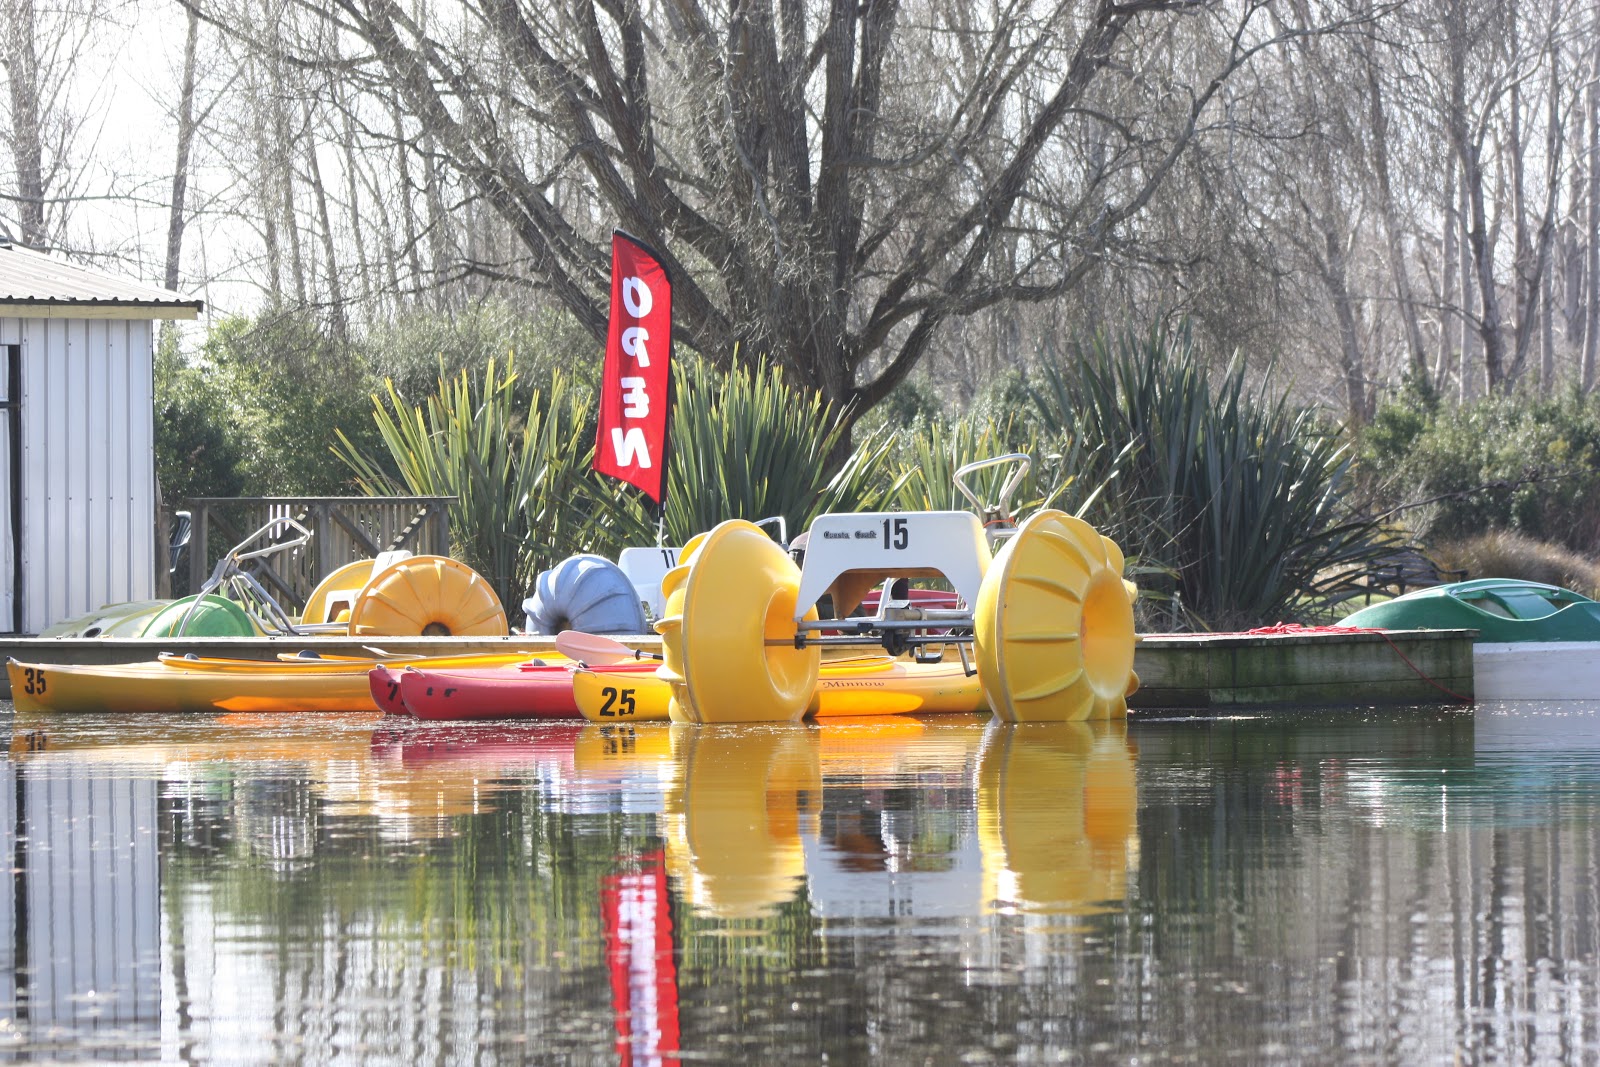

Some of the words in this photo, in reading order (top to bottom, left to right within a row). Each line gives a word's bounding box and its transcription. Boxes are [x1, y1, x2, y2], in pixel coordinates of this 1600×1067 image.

[882, 518, 909, 550] 15
[24, 668, 47, 695] 35
[822, 679, 885, 689] Minnow
[599, 686, 636, 717] 25
